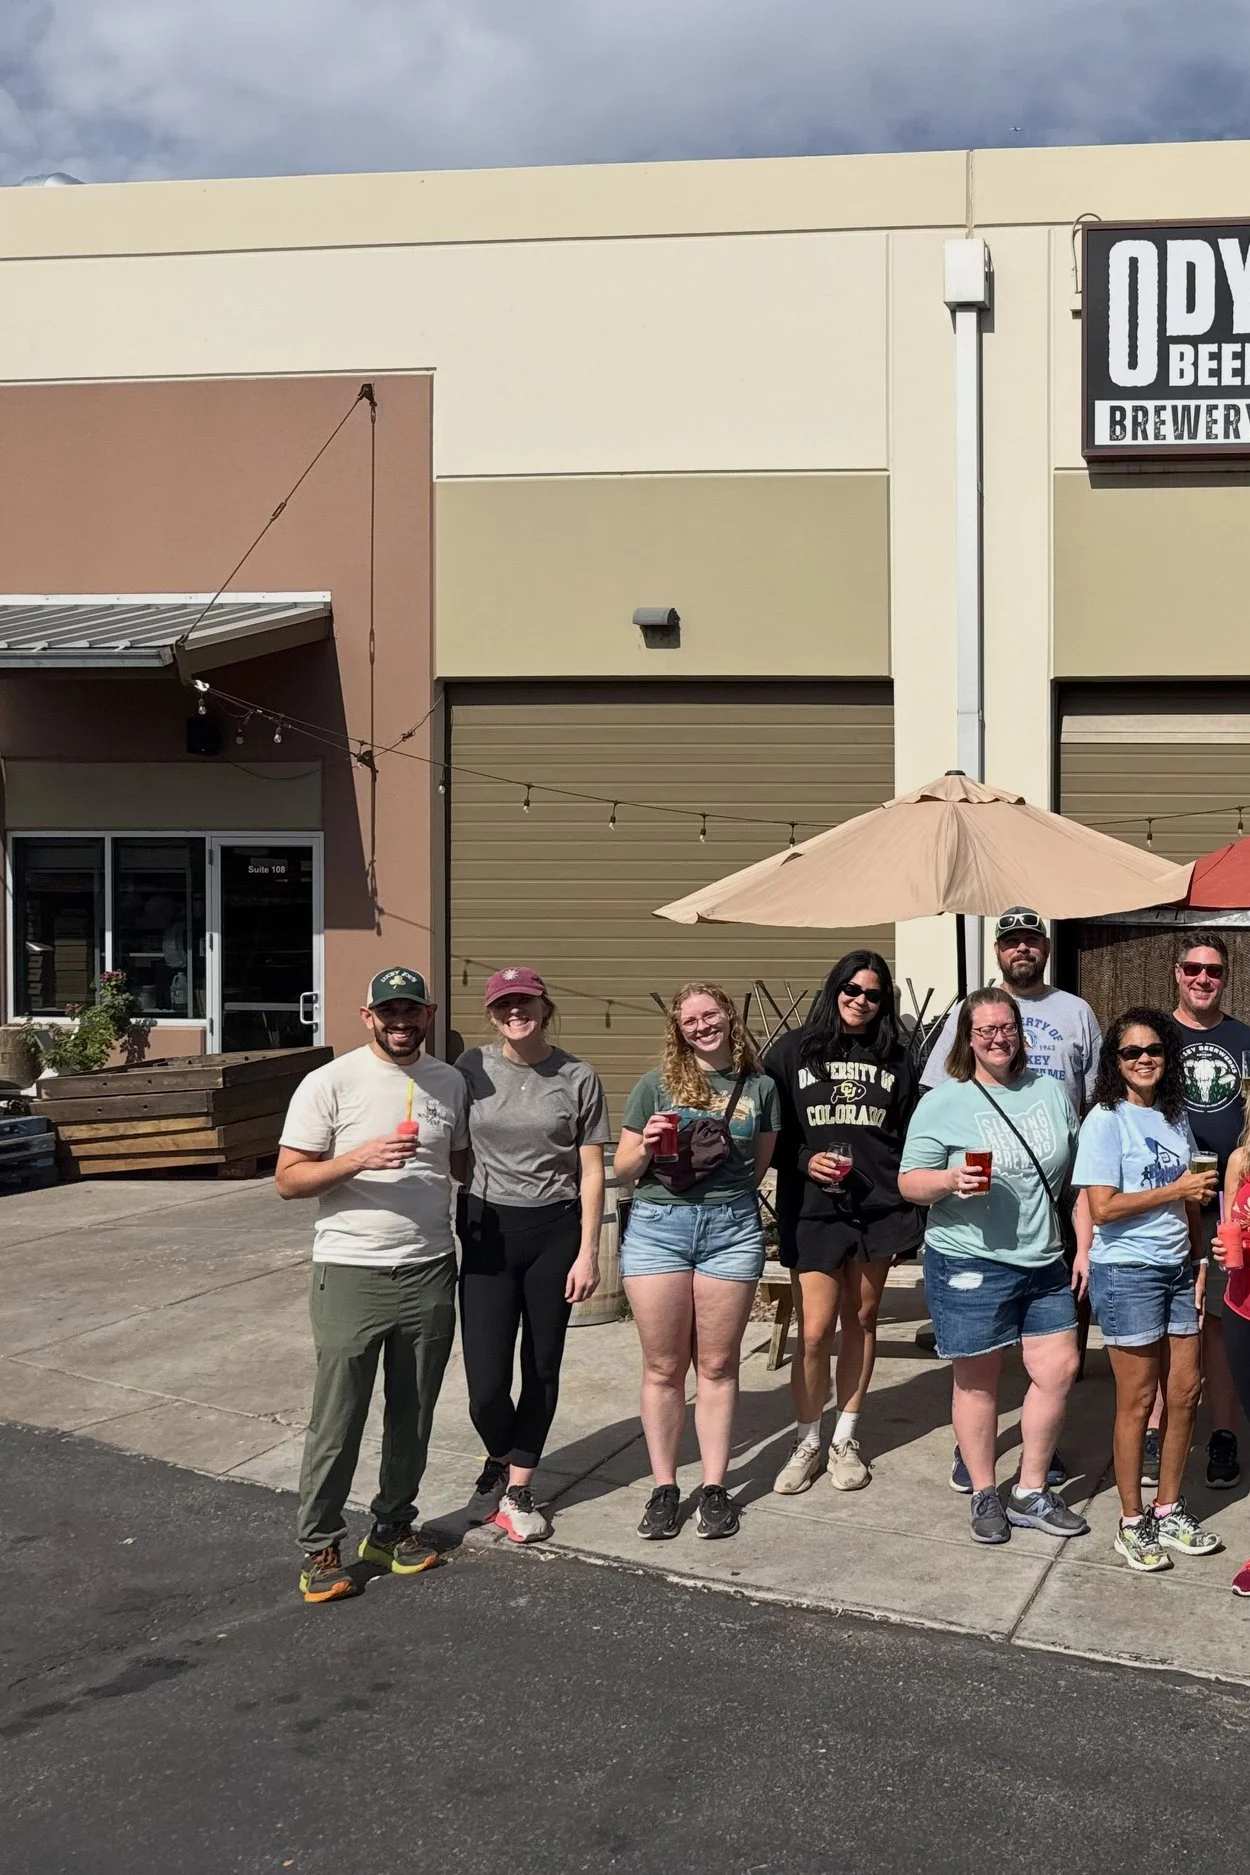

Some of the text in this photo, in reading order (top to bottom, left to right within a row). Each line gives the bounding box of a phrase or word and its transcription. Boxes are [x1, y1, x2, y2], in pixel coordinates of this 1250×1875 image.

[248, 865, 286, 874] Suite 108
[806, 1104, 887, 1127] COLORADO
